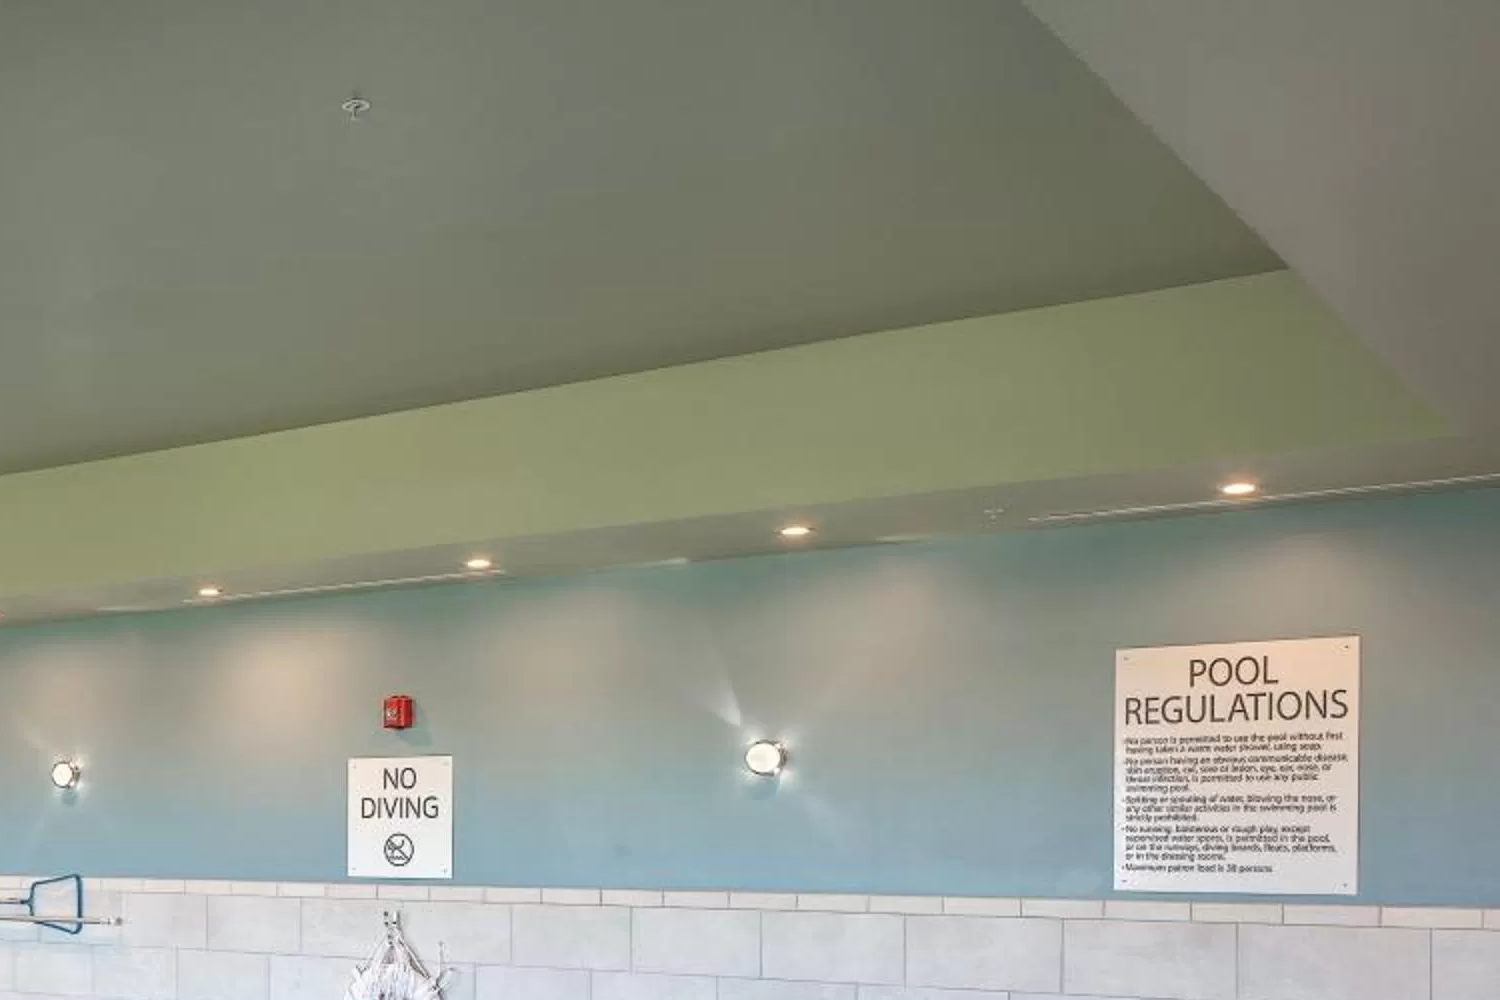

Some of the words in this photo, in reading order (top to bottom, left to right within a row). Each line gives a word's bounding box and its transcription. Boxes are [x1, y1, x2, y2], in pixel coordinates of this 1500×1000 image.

[1189, 656, 1279, 688] POOL
[1125, 689, 1349, 725] REGULATIONS
[1250, 732, 1265, 742] the
[1268, 733, 1287, 744] pool
[1290, 732, 1324, 741] without
[1170, 756, 1199, 766] having
[1248, 753, 1312, 763] communicable
[383, 767, 417, 790] NO
[1284, 793, 1299, 802] the
[361, 795, 439, 819] DIVING
[1235, 835, 1279, 843] permitted
[1291, 834, 1306, 842] the
